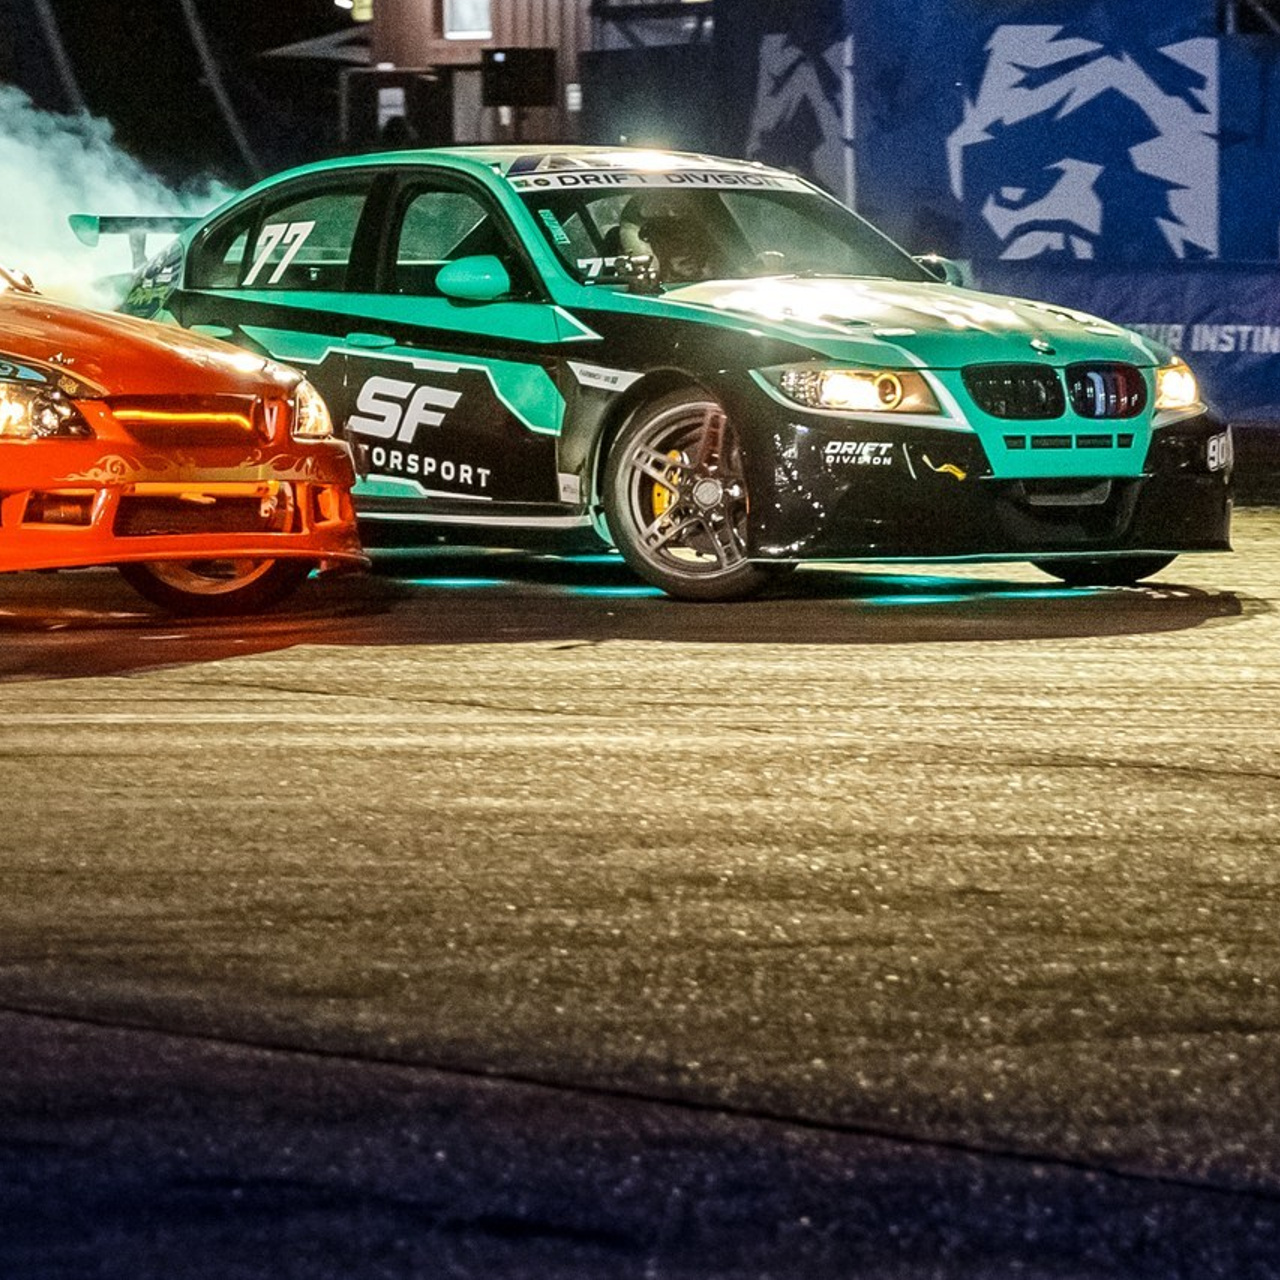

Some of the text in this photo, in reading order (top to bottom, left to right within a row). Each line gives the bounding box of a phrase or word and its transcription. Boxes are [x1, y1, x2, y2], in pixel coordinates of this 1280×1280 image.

[557, 172, 783, 188] DRIFT DIVISION
[241, 221, 316, 286] 77
[345, 376, 463, 444] SF
[824, 441, 893, 456] DRIFT
[825, 455, 892, 466] DIVISION
